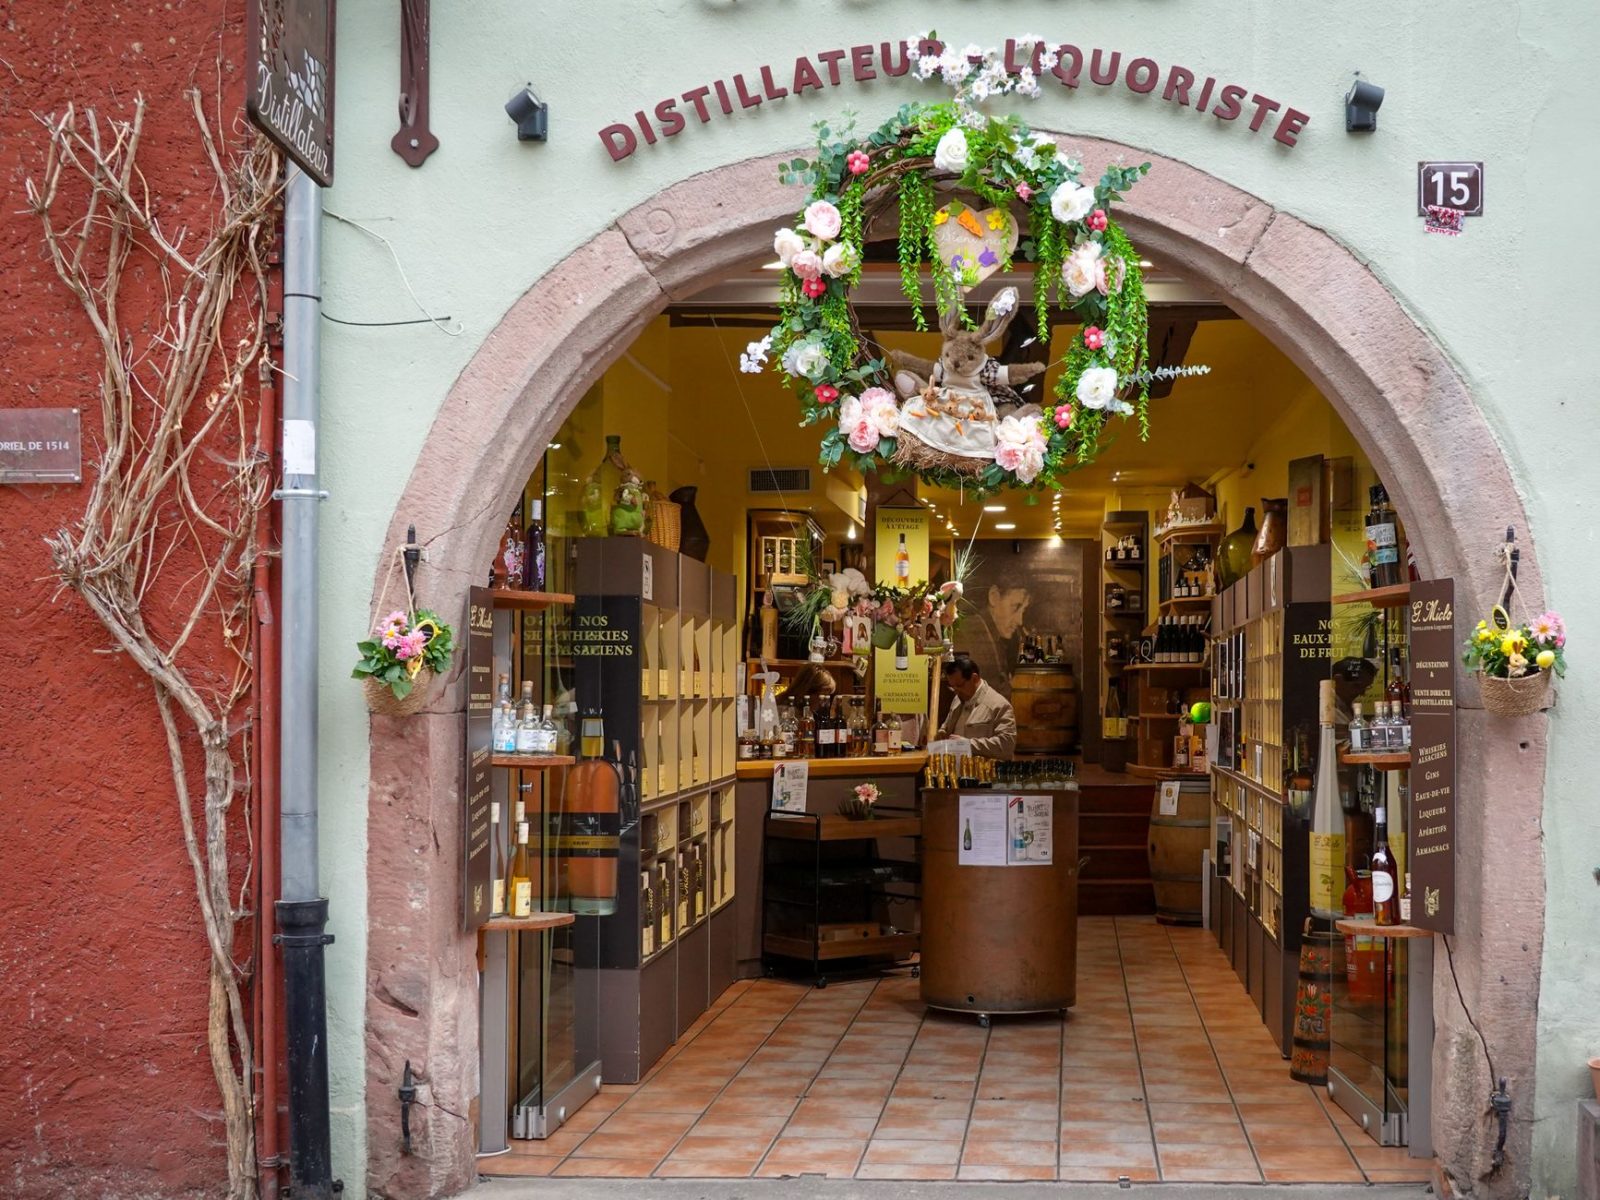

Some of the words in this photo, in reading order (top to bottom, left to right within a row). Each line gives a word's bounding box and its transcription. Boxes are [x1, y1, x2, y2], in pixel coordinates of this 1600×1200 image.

[1004, 39, 1311, 148] LIQUORISTE
[257, 60, 329, 177] Distillateur
[1431, 171, 1470, 206] 15
[28, 441, 43, 450] DE
[46, 441, 69, 450] 1514
[1423, 600, 1453, 622] Miclo
[579, 615, 608, 627] NOS
[1300, 648, 1316, 658] DE
[1418, 749, 1447, 764] ALSACIENS
[1418, 806, 1447, 819] LIQUEURS
[1415, 843, 1450, 856] ARMAGNACS
